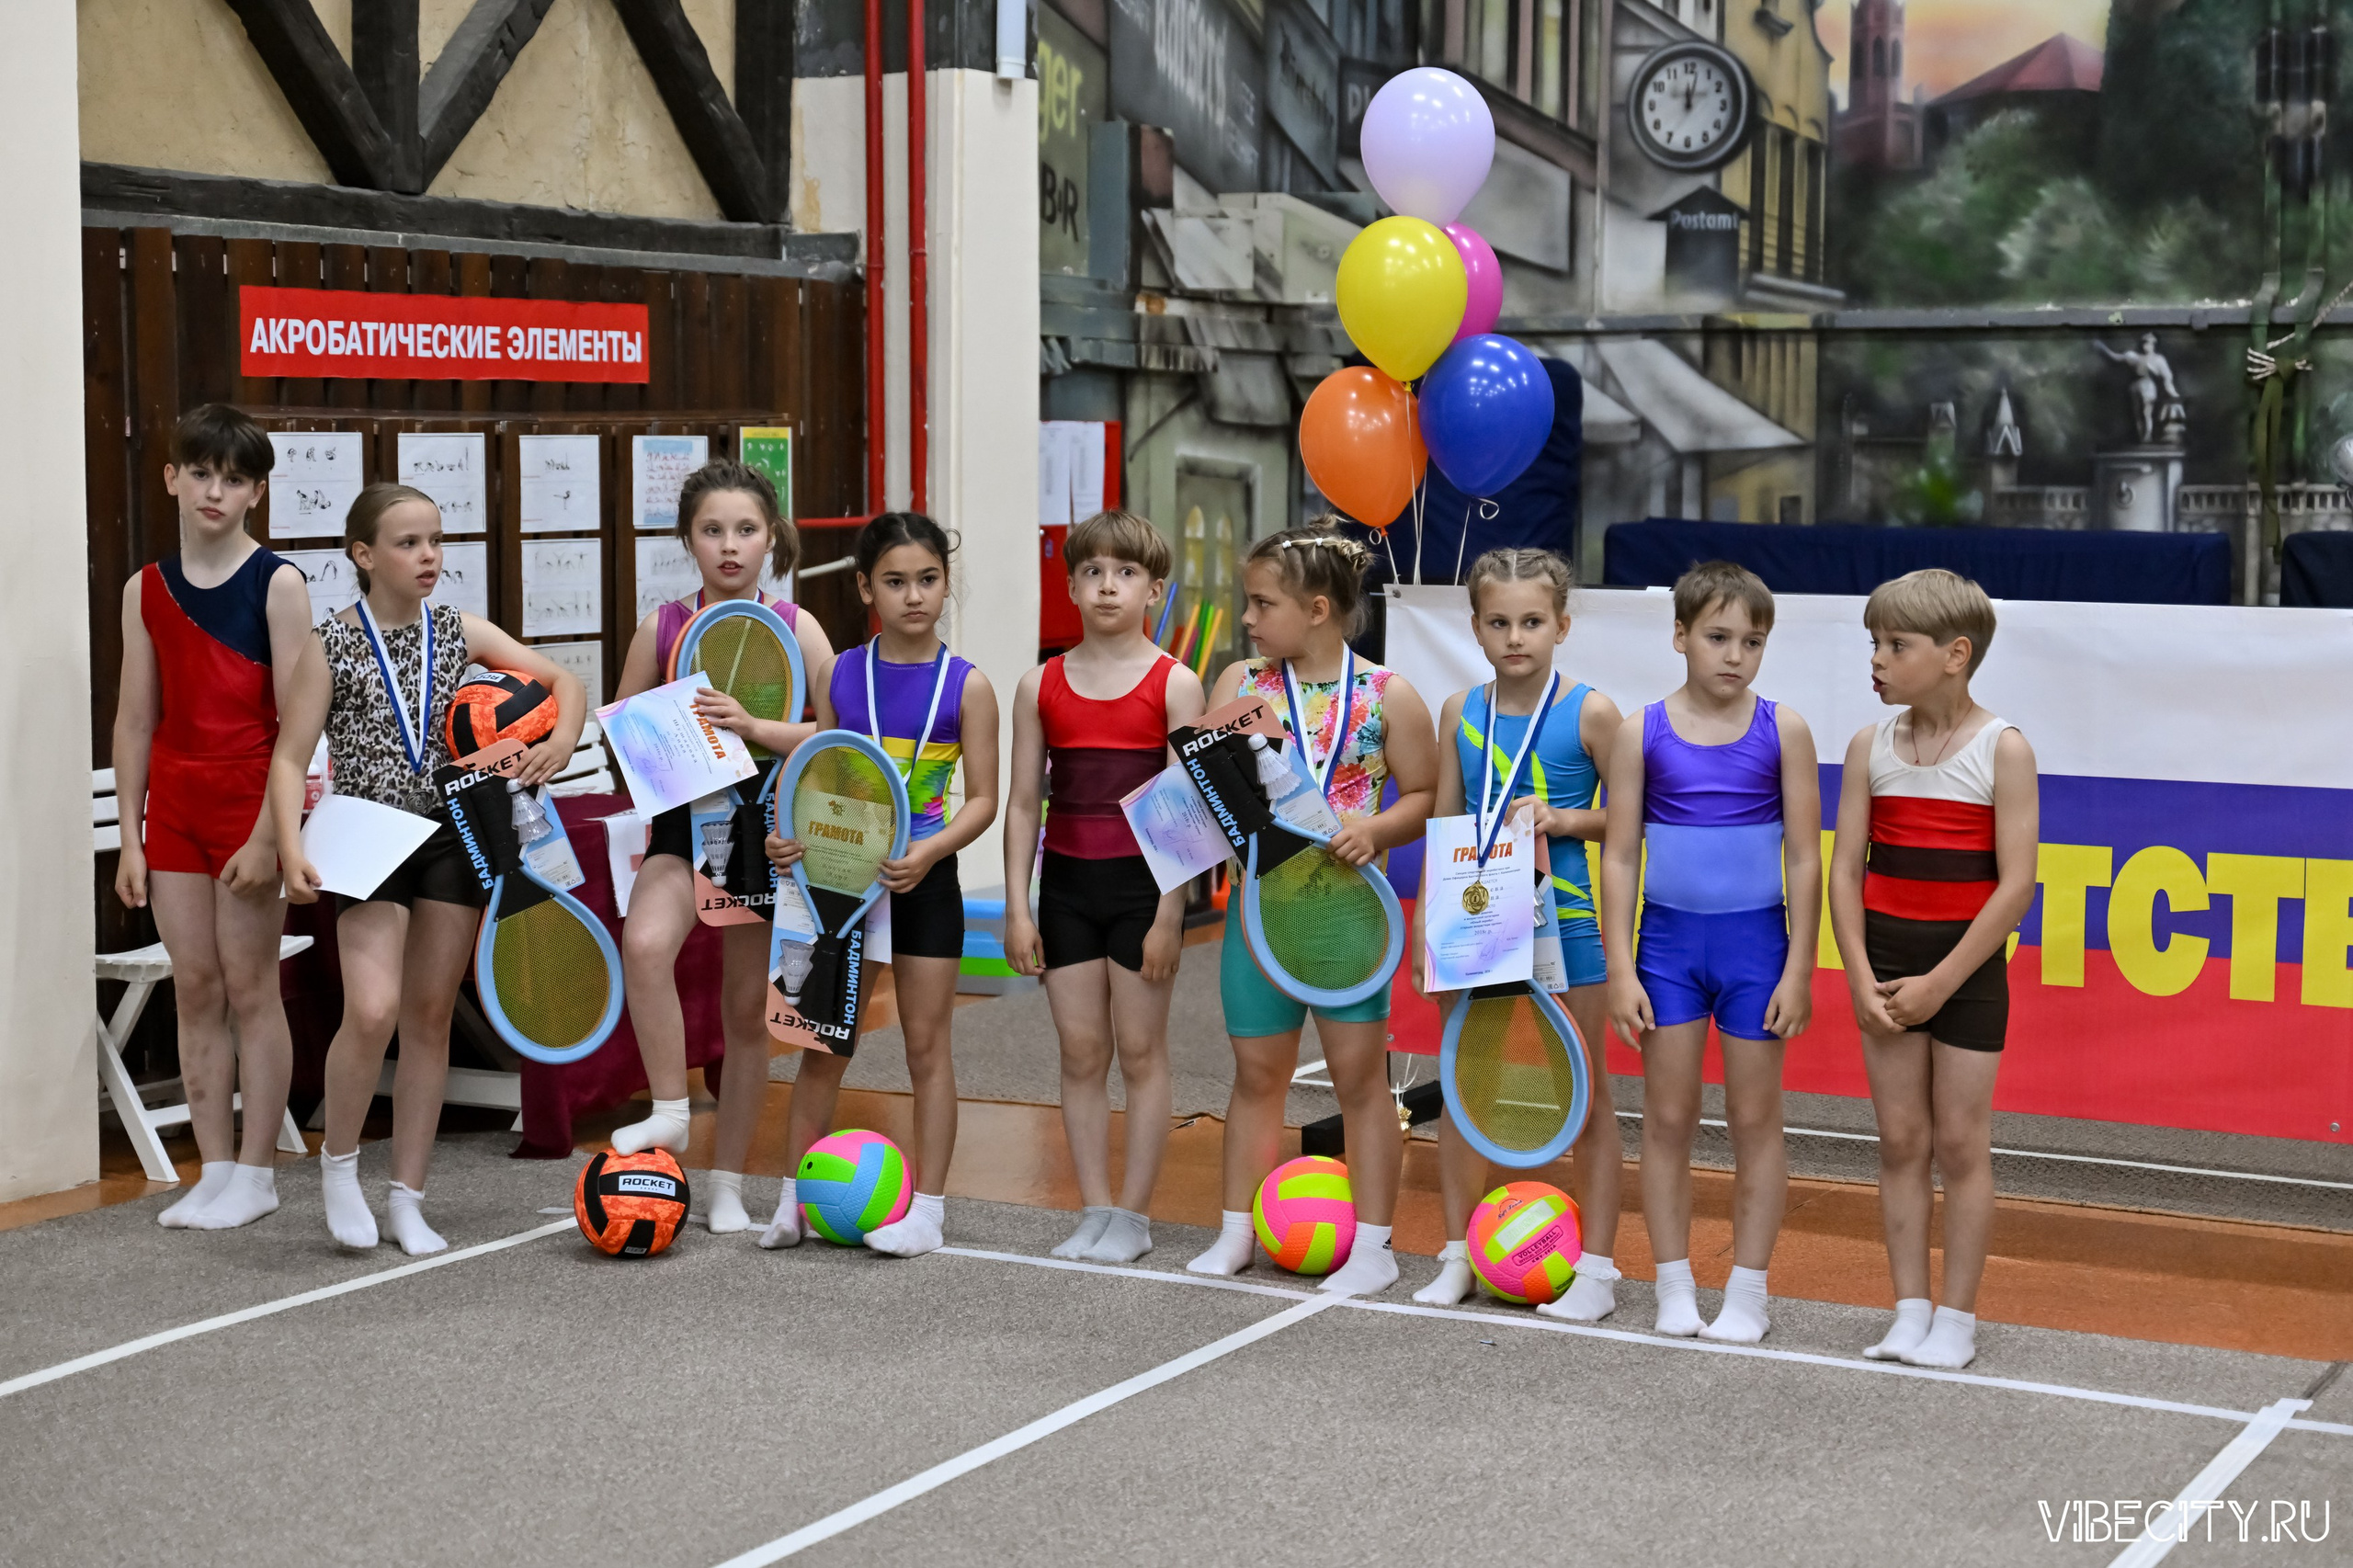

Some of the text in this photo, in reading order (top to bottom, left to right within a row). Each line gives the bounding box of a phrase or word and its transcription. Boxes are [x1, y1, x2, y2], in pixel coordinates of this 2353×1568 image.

[1666, 68, 1677, 80] 11
[1684, 62, 1697, 74] 12
[1653, 81, 1665, 93] 10
[1715, 81, 1722, 93] 2
[1648, 99, 1656, 111] 9
[1720, 99, 1727, 112] 3
[1713, 119, 1721, 131] 4
[1666, 131, 1674, 144] 7
[1684, 136, 1691, 149] 6
[1702, 131, 1710, 143] 5
[250, 317, 642, 363] АКРОБАТИЧЕСКИЕ ЭЛЕМЕНТЫ
[1182, 705, 1264, 757] ROCKET
[445, 750, 523, 796] ROCKET
[1187, 757, 1246, 847] БАДМИНТОН
[809, 820, 864, 846] ГРАМОТА
[447, 797, 494, 890] БАДМИНТОН
[1453, 841, 1513, 863] ГРАОТА
[701, 892, 778, 911] ROCKET
[844, 929, 862, 1026] БАДМИНТОН
[770, 1012, 850, 1040] ROCKET
[622, 1177, 673, 1190] ROCKET
[1518, 1231, 1557, 1259] VOLLEYBALL
